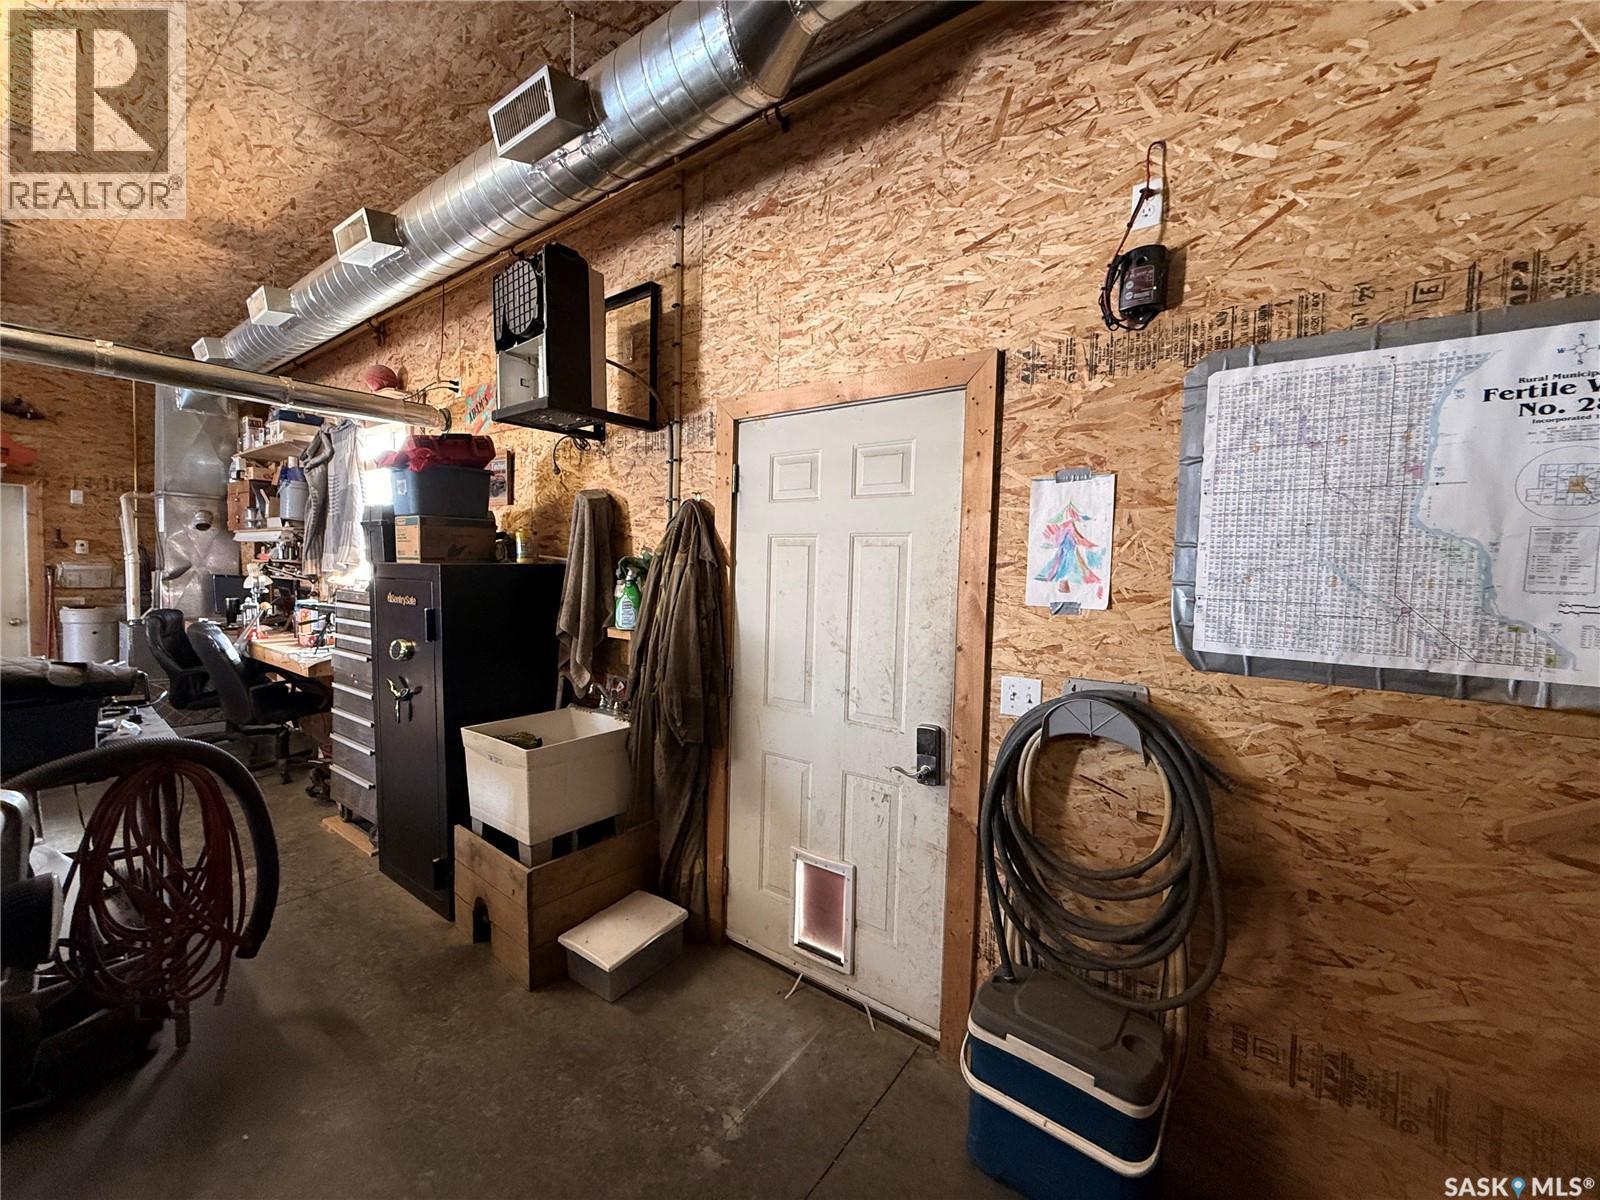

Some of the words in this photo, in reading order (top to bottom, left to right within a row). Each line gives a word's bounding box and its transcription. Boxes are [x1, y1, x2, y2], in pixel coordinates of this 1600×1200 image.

[1518, 375, 1549, 384] Rural
[1482, 381, 1577, 403] Fertile
[1517, 402, 1566, 417] No.
[1576, 397, 1600, 413] 2
[1532, 414, 1592, 424] Incorporated
